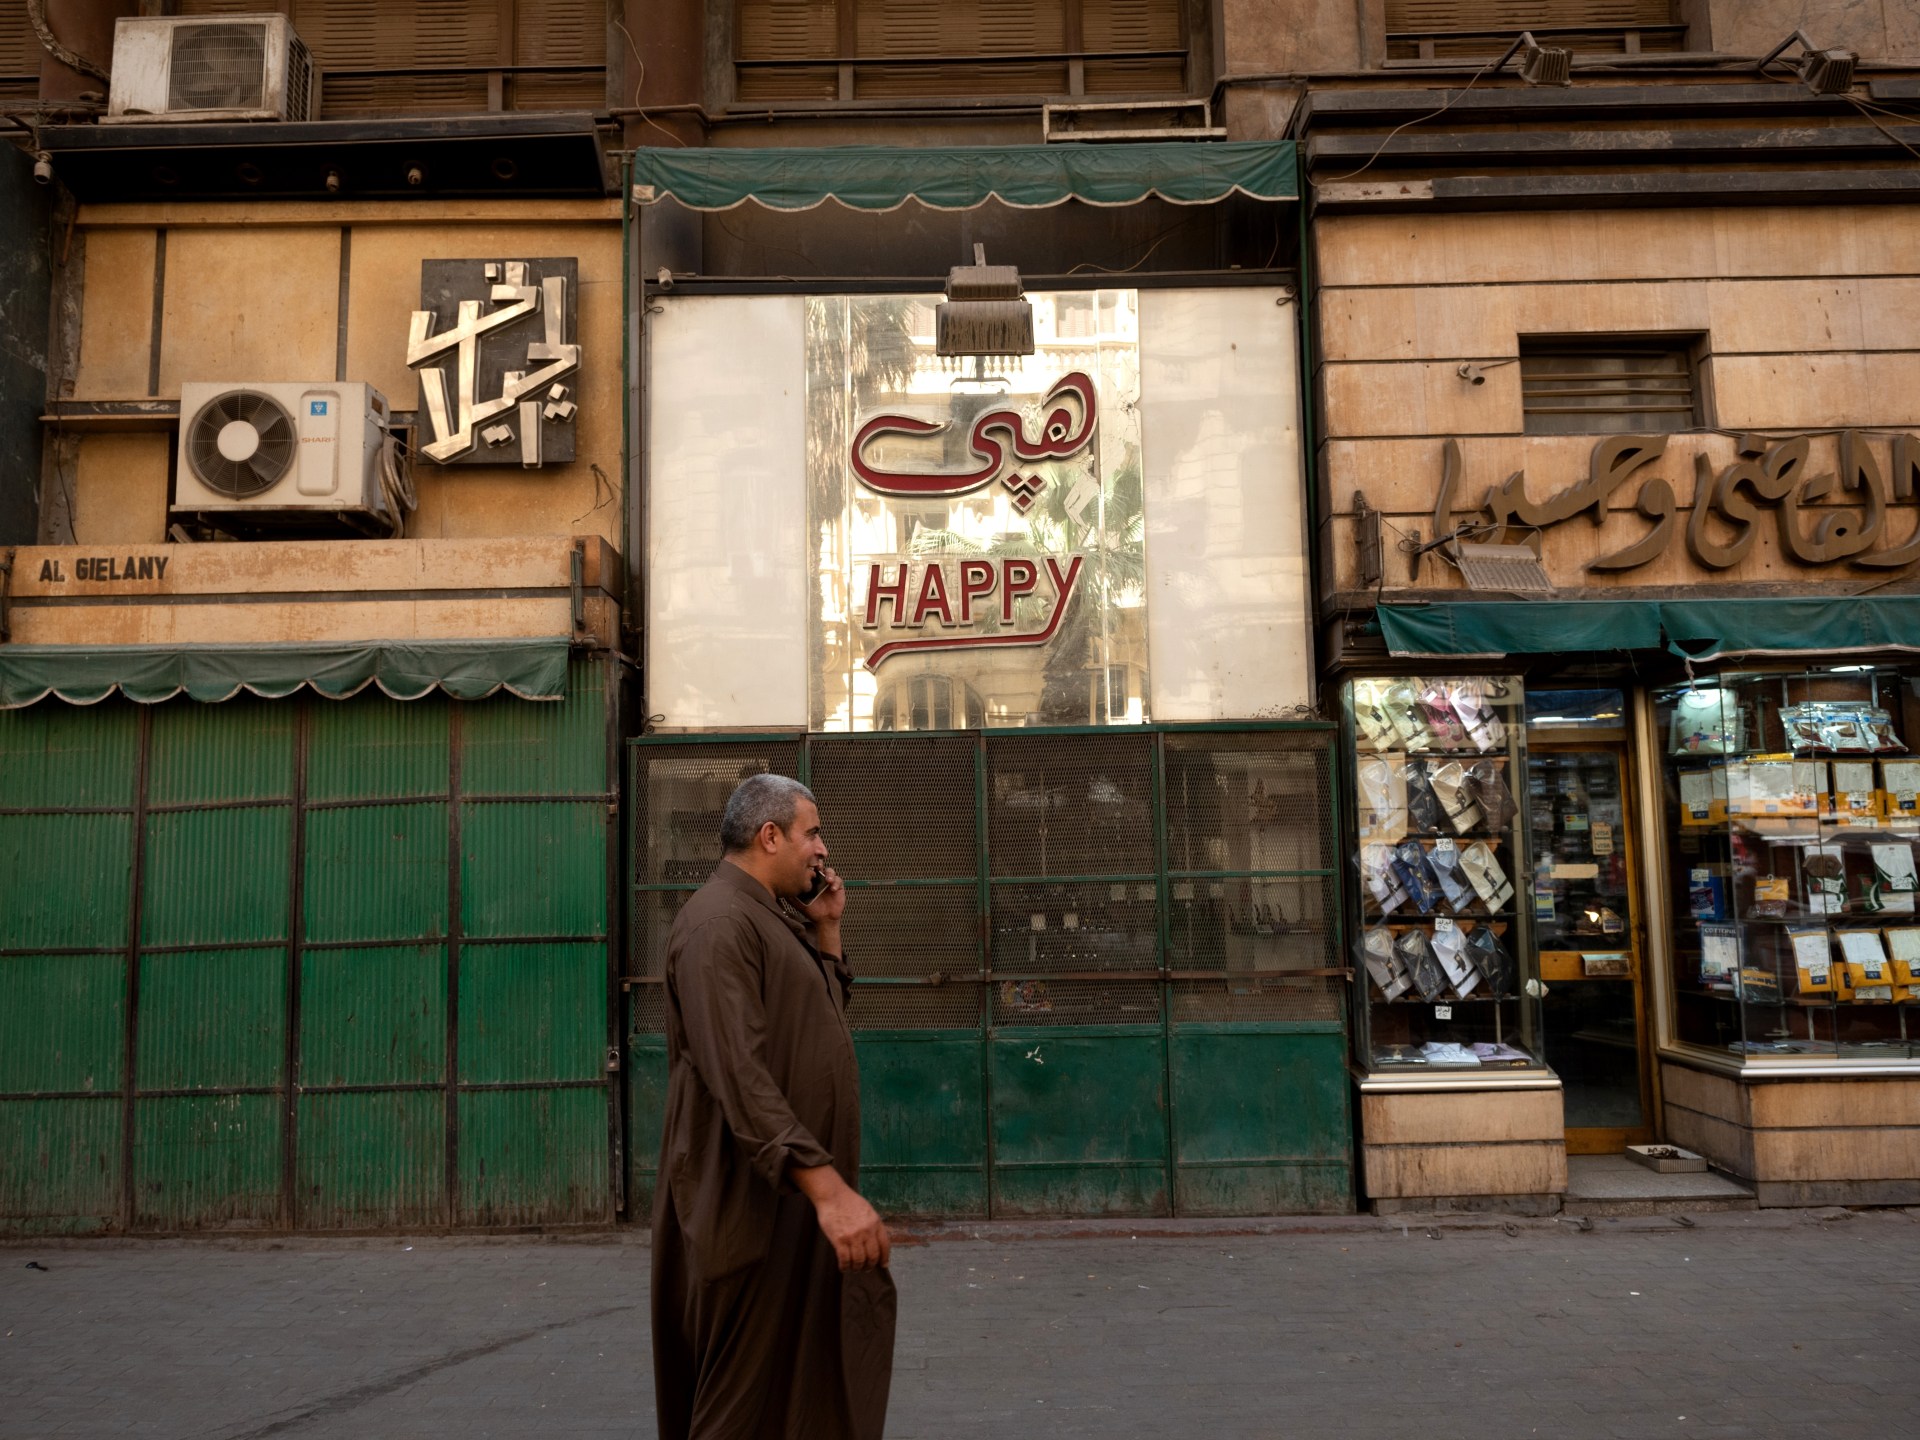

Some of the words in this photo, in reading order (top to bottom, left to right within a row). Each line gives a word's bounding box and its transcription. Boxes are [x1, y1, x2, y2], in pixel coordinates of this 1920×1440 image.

[39, 559, 65, 583] AL
[76, 556, 168, 582] GIELANY
[862, 553, 1085, 674] HAPPY
